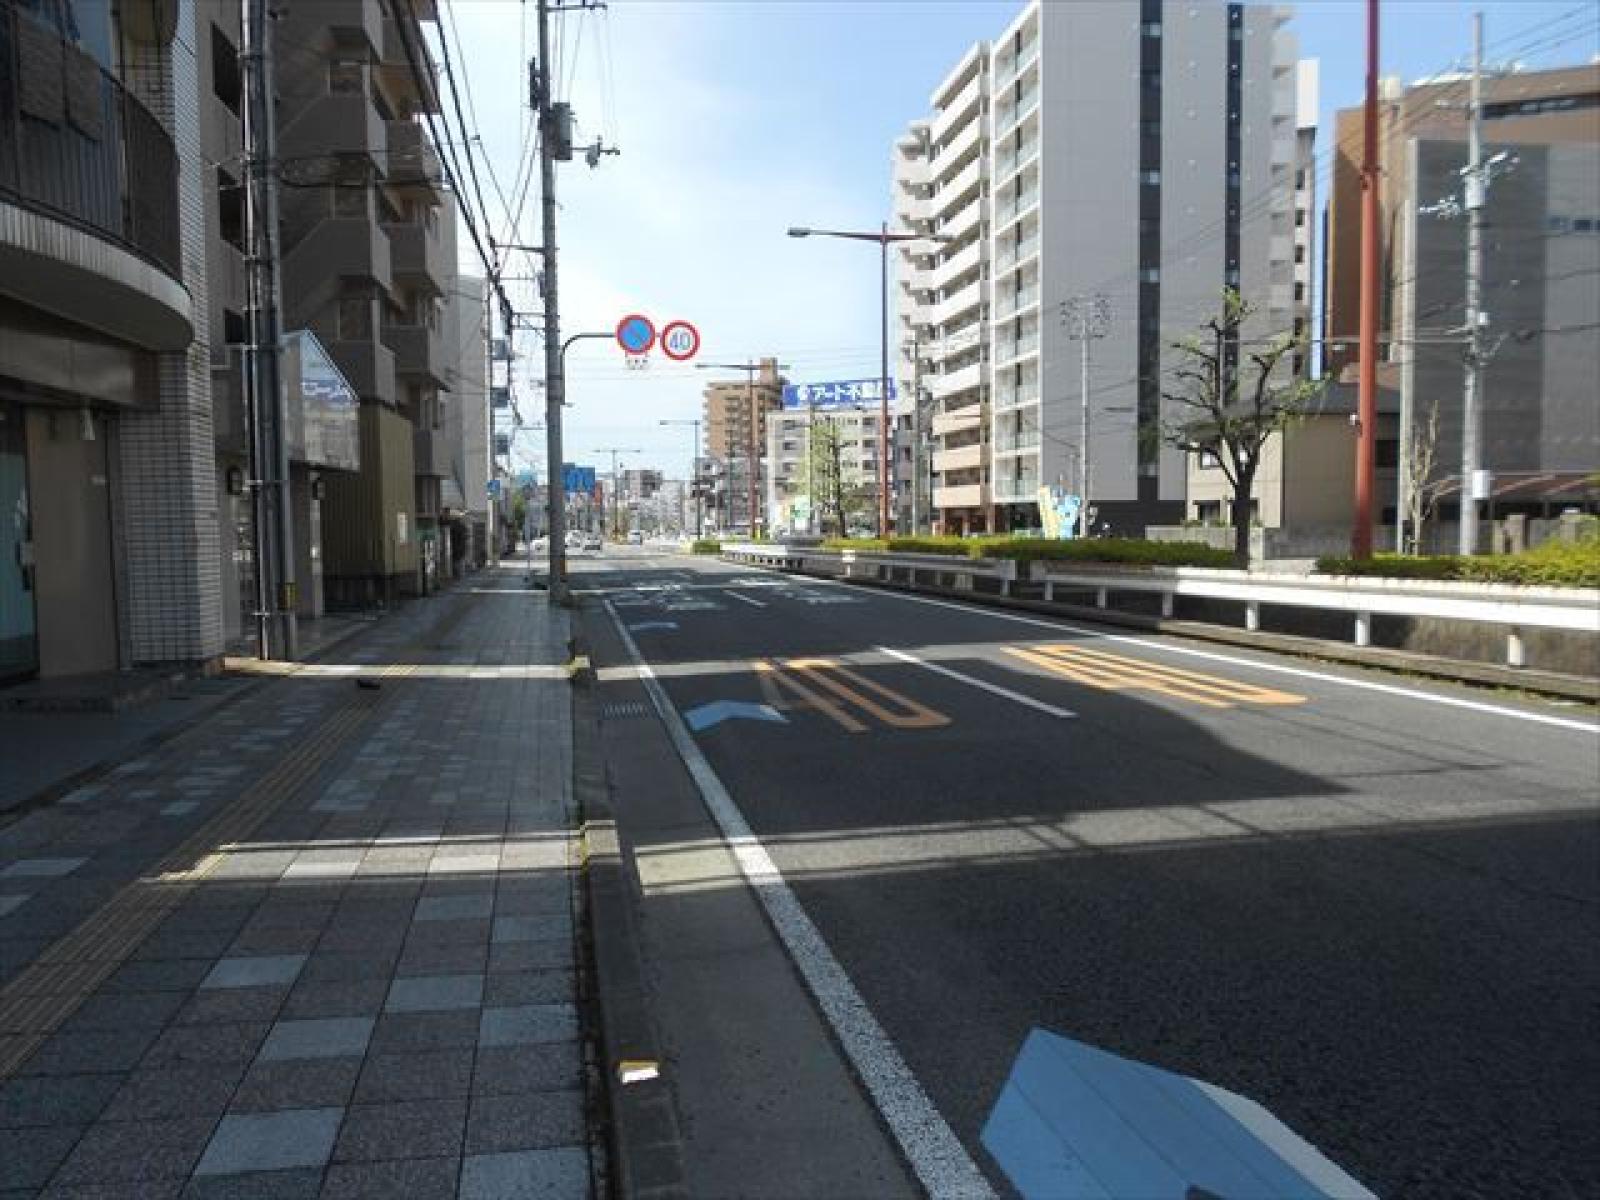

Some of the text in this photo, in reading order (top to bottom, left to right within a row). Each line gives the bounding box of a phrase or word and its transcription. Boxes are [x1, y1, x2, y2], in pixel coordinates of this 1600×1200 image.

[669, 331, 690, 350] 40
[756, 656, 952, 731] 40
[1000, 644, 1307, 708] 40
